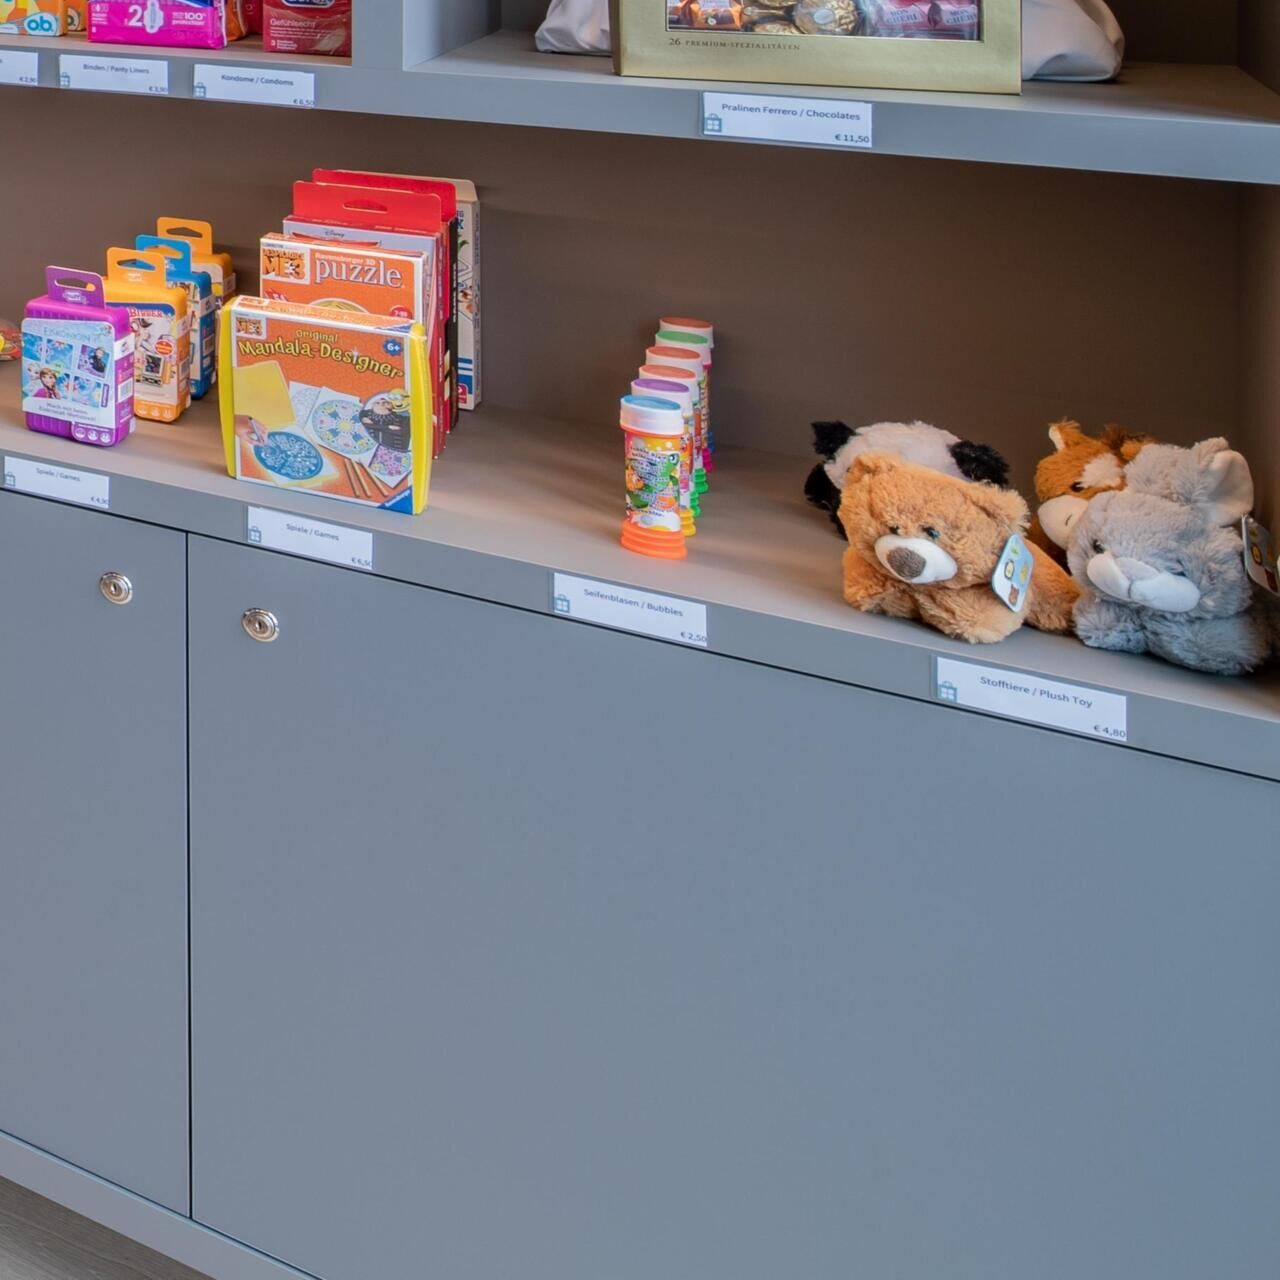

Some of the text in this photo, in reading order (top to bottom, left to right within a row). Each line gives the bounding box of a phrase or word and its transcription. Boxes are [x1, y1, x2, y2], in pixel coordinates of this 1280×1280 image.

[270, 18, 316, 28] Gefühlsecht
[669, 38, 801, 51] 26 PREMIUM-SPEZIALITÄTEN
[83, 63, 150, 75] Binden Panty Liners
[221, 74, 294, 87] Kondome Condoms
[721, 102, 761, 113] Pralinen
[763, 106, 798, 116] Ferrero
[806, 109, 861, 121] Chocolates
[843, 133, 870, 145] 11,50
[324, 229, 345, 238] Disney
[315, 252, 363, 264] Ravensburger
[314, 257, 403, 289] puzzle
[296, 328, 338, 343] Original
[386, 342, 401, 352] 6+
[238, 337, 404, 380] Mandala-Designer
[35, 467, 81, 483] Spiele Games
[286, 523, 308, 536] Spiele
[314, 530, 339, 541] Games
[584, 588, 639, 608] Seifenblasen
[647, 602, 684, 617] Bubbles
[688, 632, 707, 643] 2,50
[980, 676, 1031, 695] Stofftiere
[1039, 689, 1070, 703] Plush
[1072, 695, 1093, 709] Toy
[1102, 725, 1126, 738] 4,80
